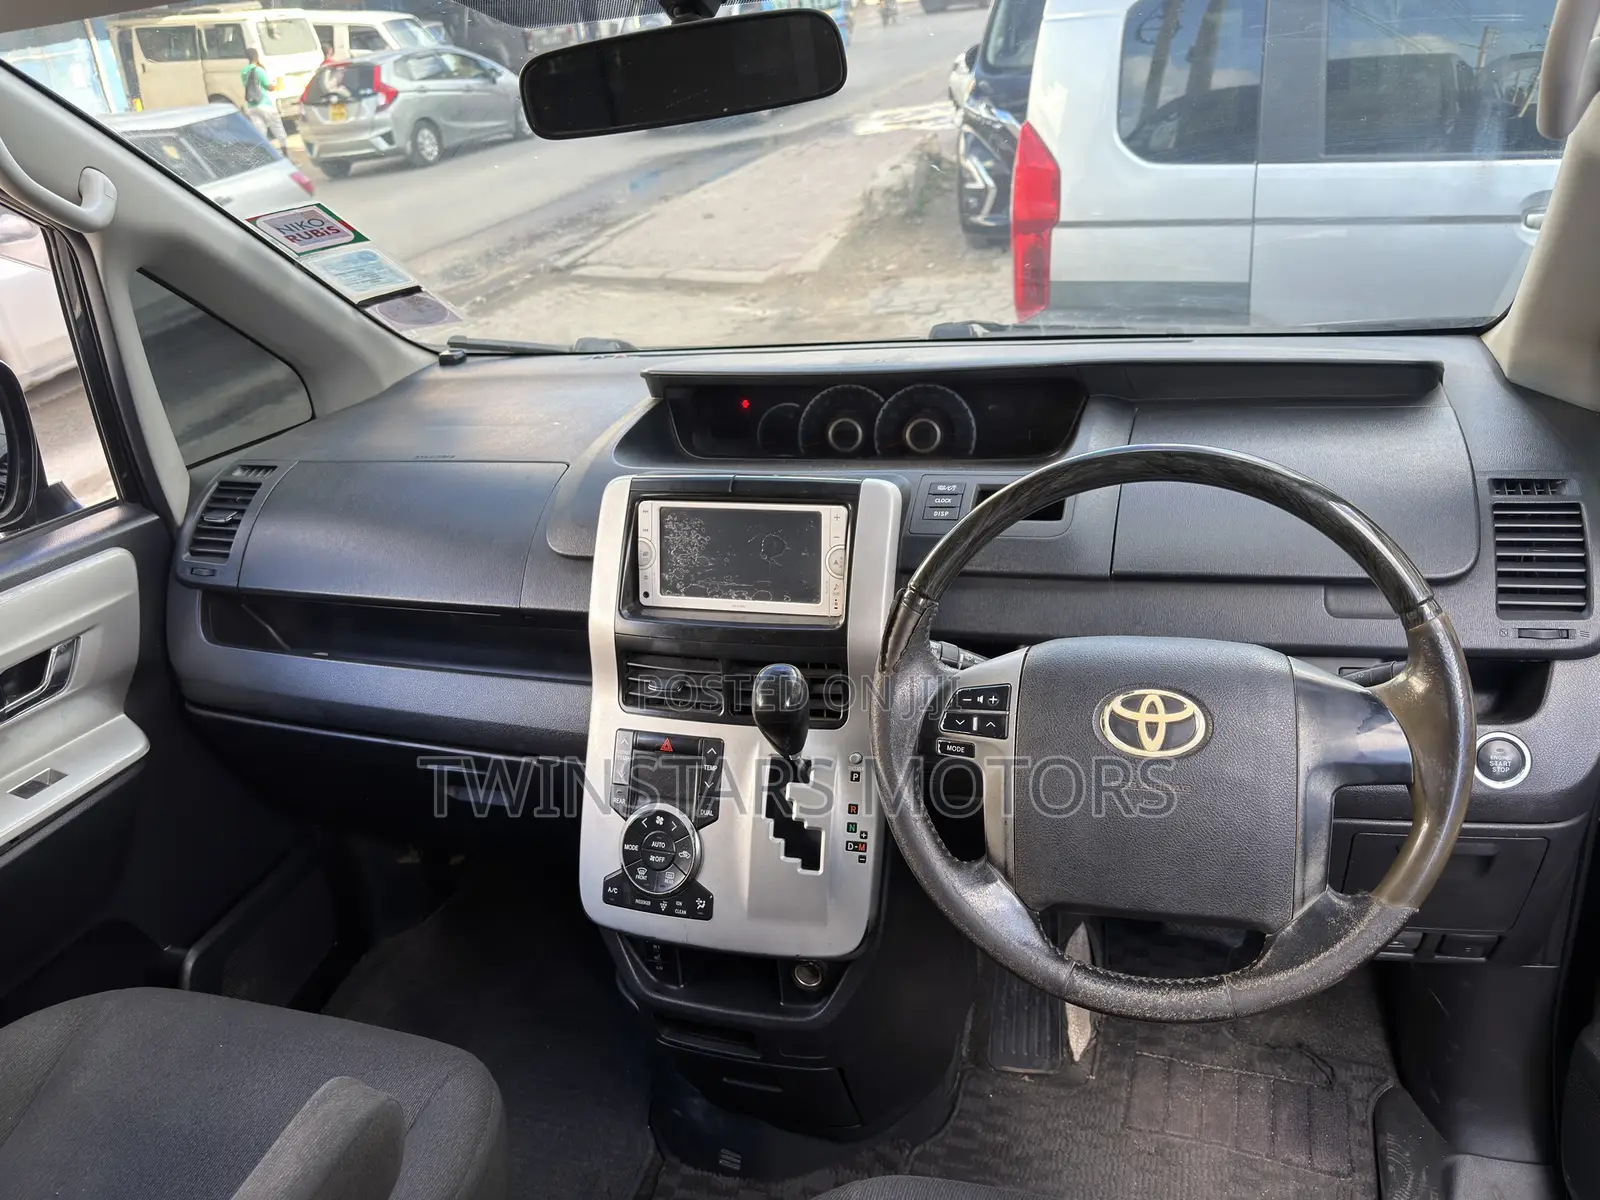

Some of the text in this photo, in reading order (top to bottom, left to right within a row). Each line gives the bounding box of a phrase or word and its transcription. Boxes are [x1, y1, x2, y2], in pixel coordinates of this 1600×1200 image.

[276, 219, 325, 235] NIKO
[946, 745, 965, 753] MODE
[852, 773, 859, 781] P
[848, 824, 856, 832] N
[651, 841, 666, 849] AUTO
[607, 886, 618, 894] A/C
